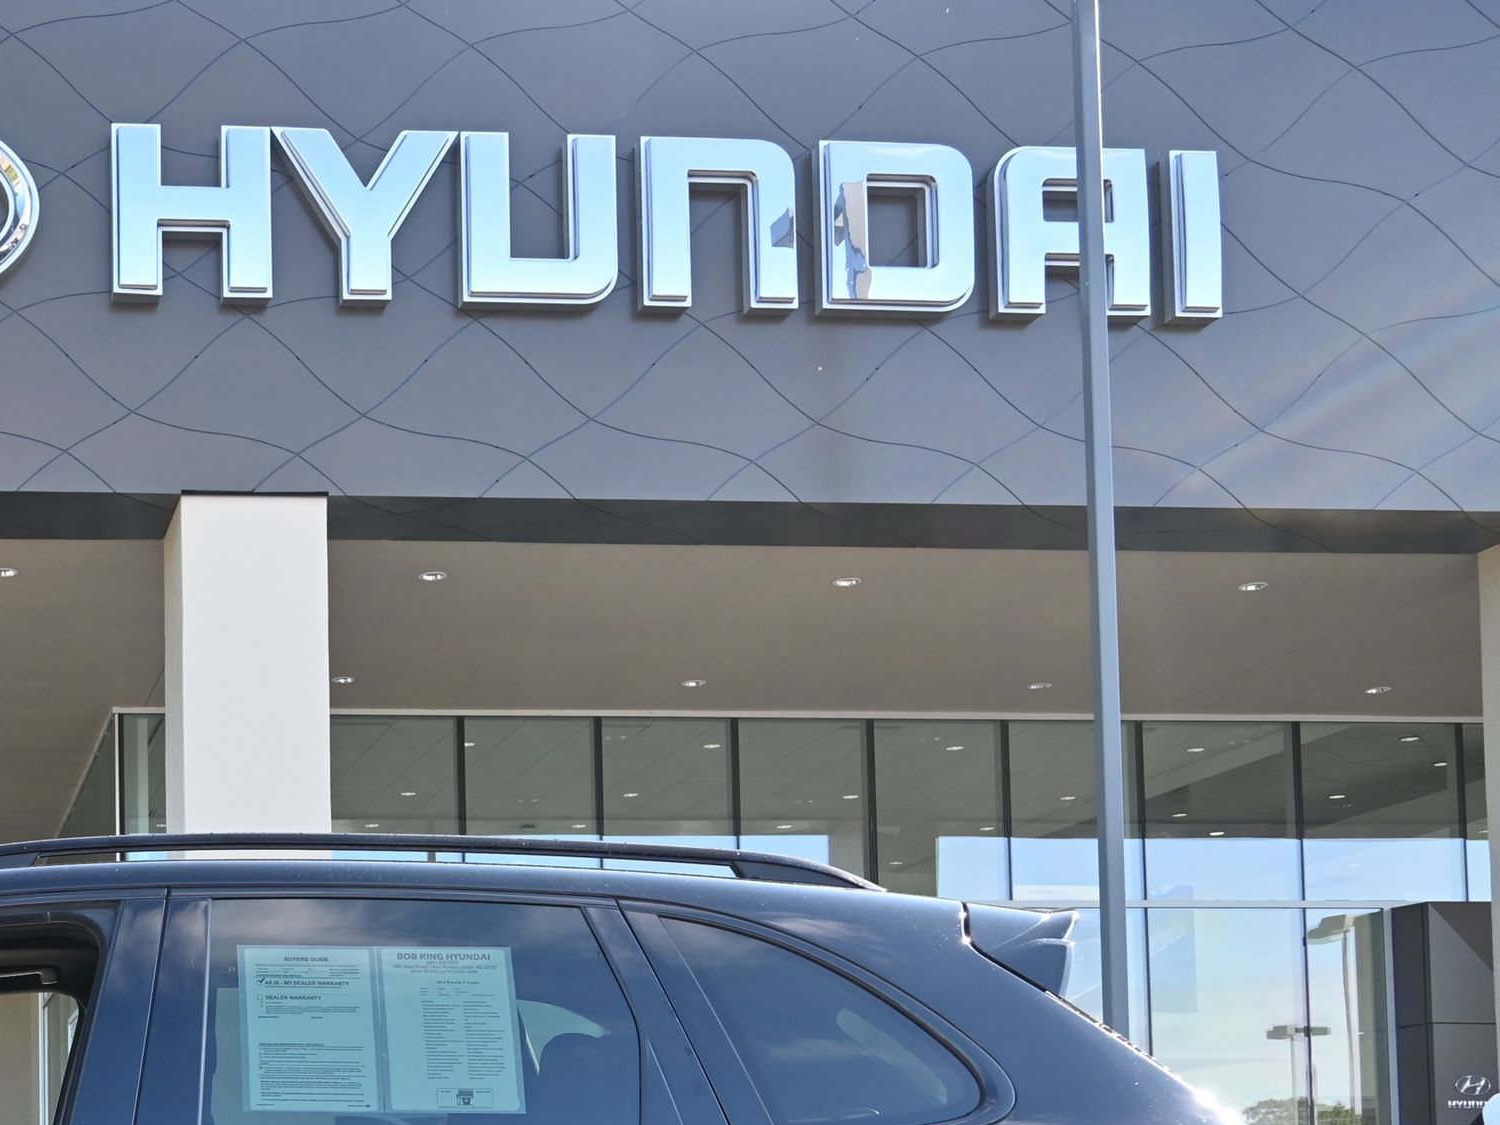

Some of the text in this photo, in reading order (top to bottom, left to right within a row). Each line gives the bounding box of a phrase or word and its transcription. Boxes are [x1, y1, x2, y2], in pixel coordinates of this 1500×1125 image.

[110, 122, 1223, 323] HYUNDAI
[396, 952, 491, 961] BOB KING HYUNDAI
